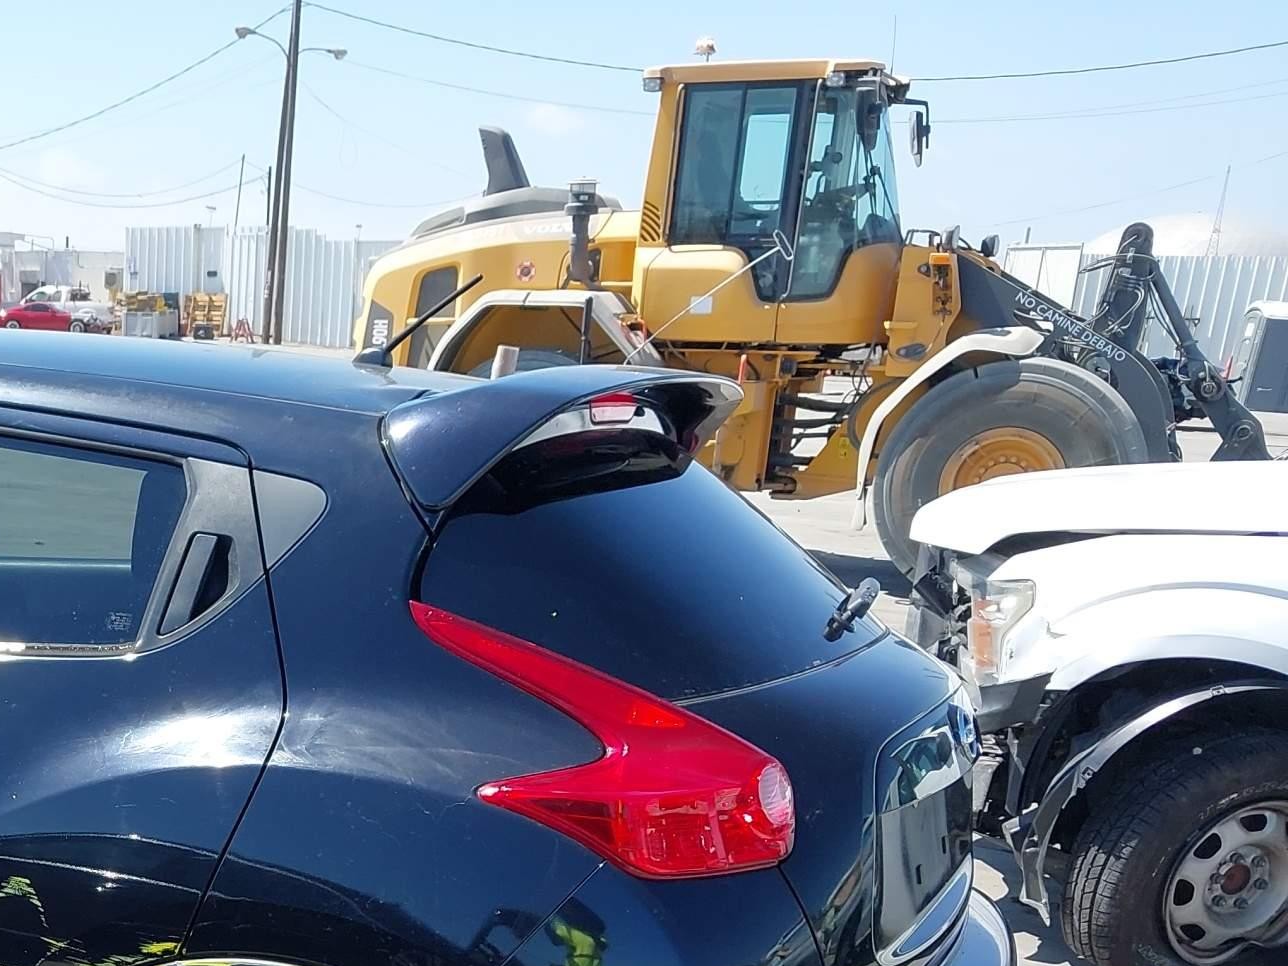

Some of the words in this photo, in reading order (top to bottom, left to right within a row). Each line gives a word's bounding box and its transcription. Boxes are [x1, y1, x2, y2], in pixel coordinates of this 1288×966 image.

[1015, 291, 1035, 308] NO
[1037, 305, 1082, 336] CAMINE
[1081, 330, 1126, 361] DEBAJO
